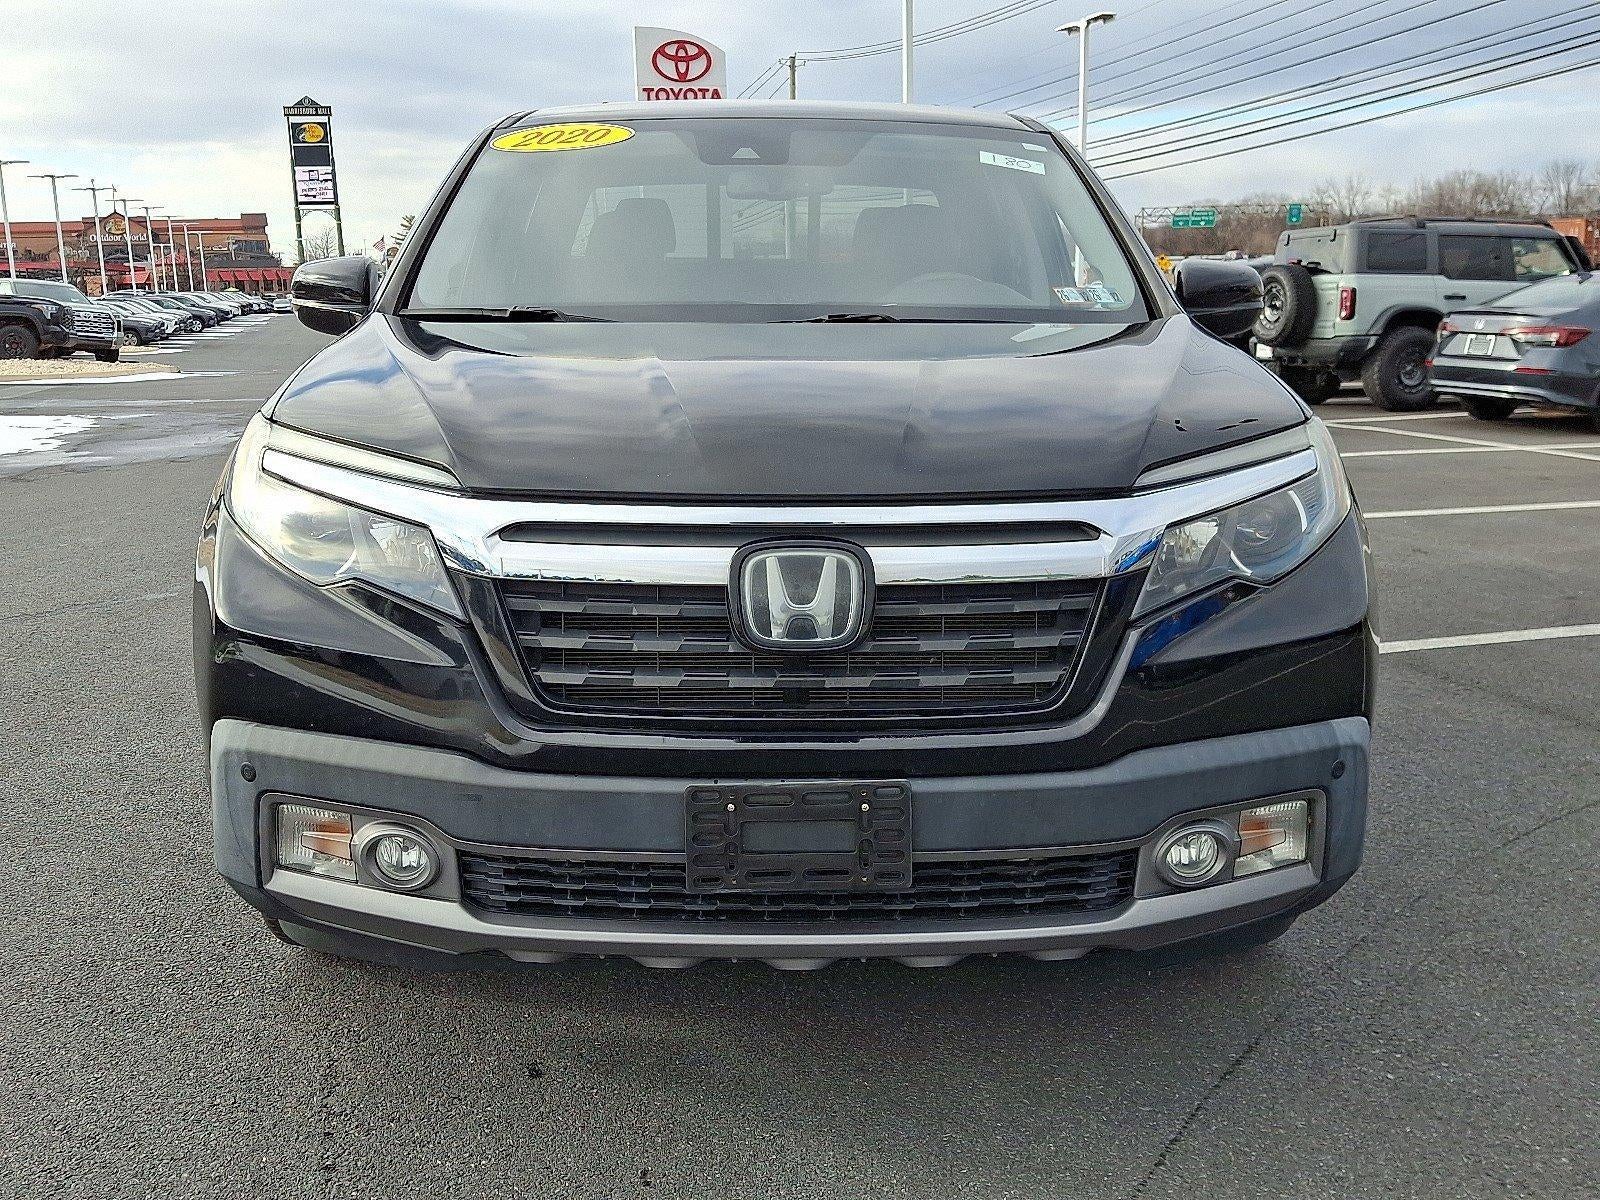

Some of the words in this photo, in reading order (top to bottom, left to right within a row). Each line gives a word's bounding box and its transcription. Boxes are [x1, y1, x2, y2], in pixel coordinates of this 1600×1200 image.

[642, 87, 722, 100] TOYOTA
[317, 107, 330, 115] MALL
[511, 128, 612, 148] 2020
[90, 234, 122, 242] Otdoor
